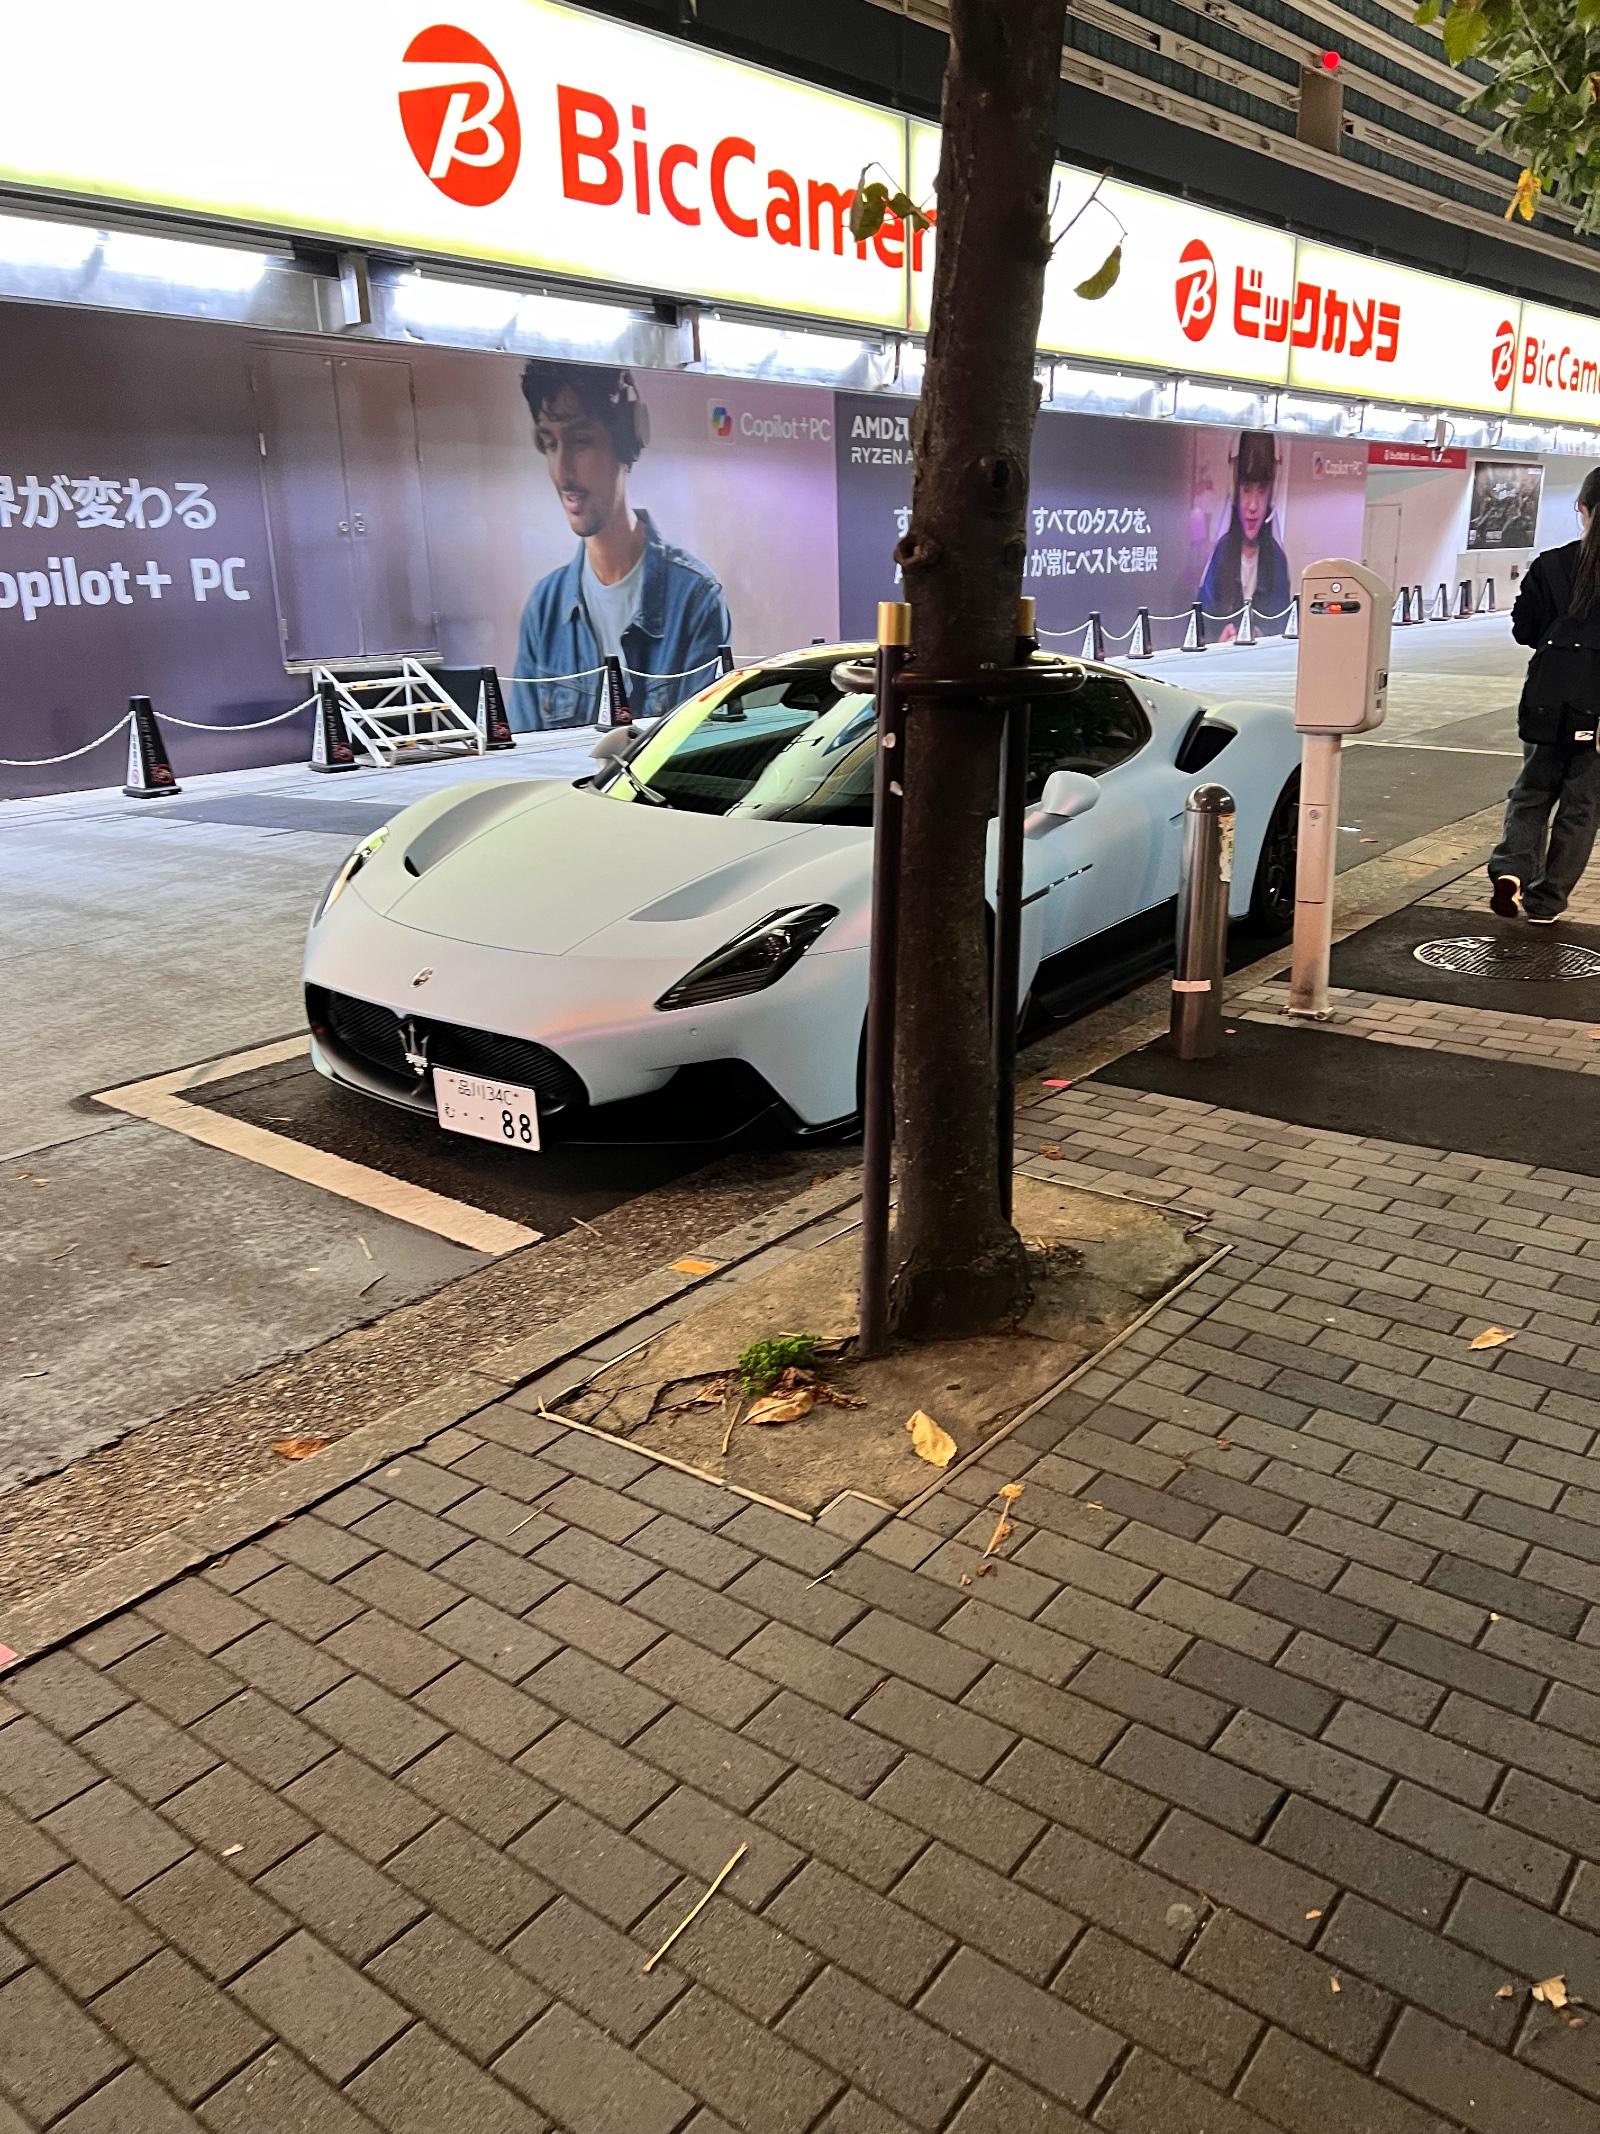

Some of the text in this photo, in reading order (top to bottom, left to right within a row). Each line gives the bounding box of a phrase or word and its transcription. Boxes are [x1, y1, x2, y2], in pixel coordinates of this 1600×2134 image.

[1233, 264, 1401, 363] ビックカメラ
[1522, 336, 1600, 394] BicCam
[851, 415, 894, 440] AMD
[851, 446, 903, 464] RYZEN
[1032, 507, 1152, 535] すべてのタスクを、
[190, 557, 250, 602] PC
